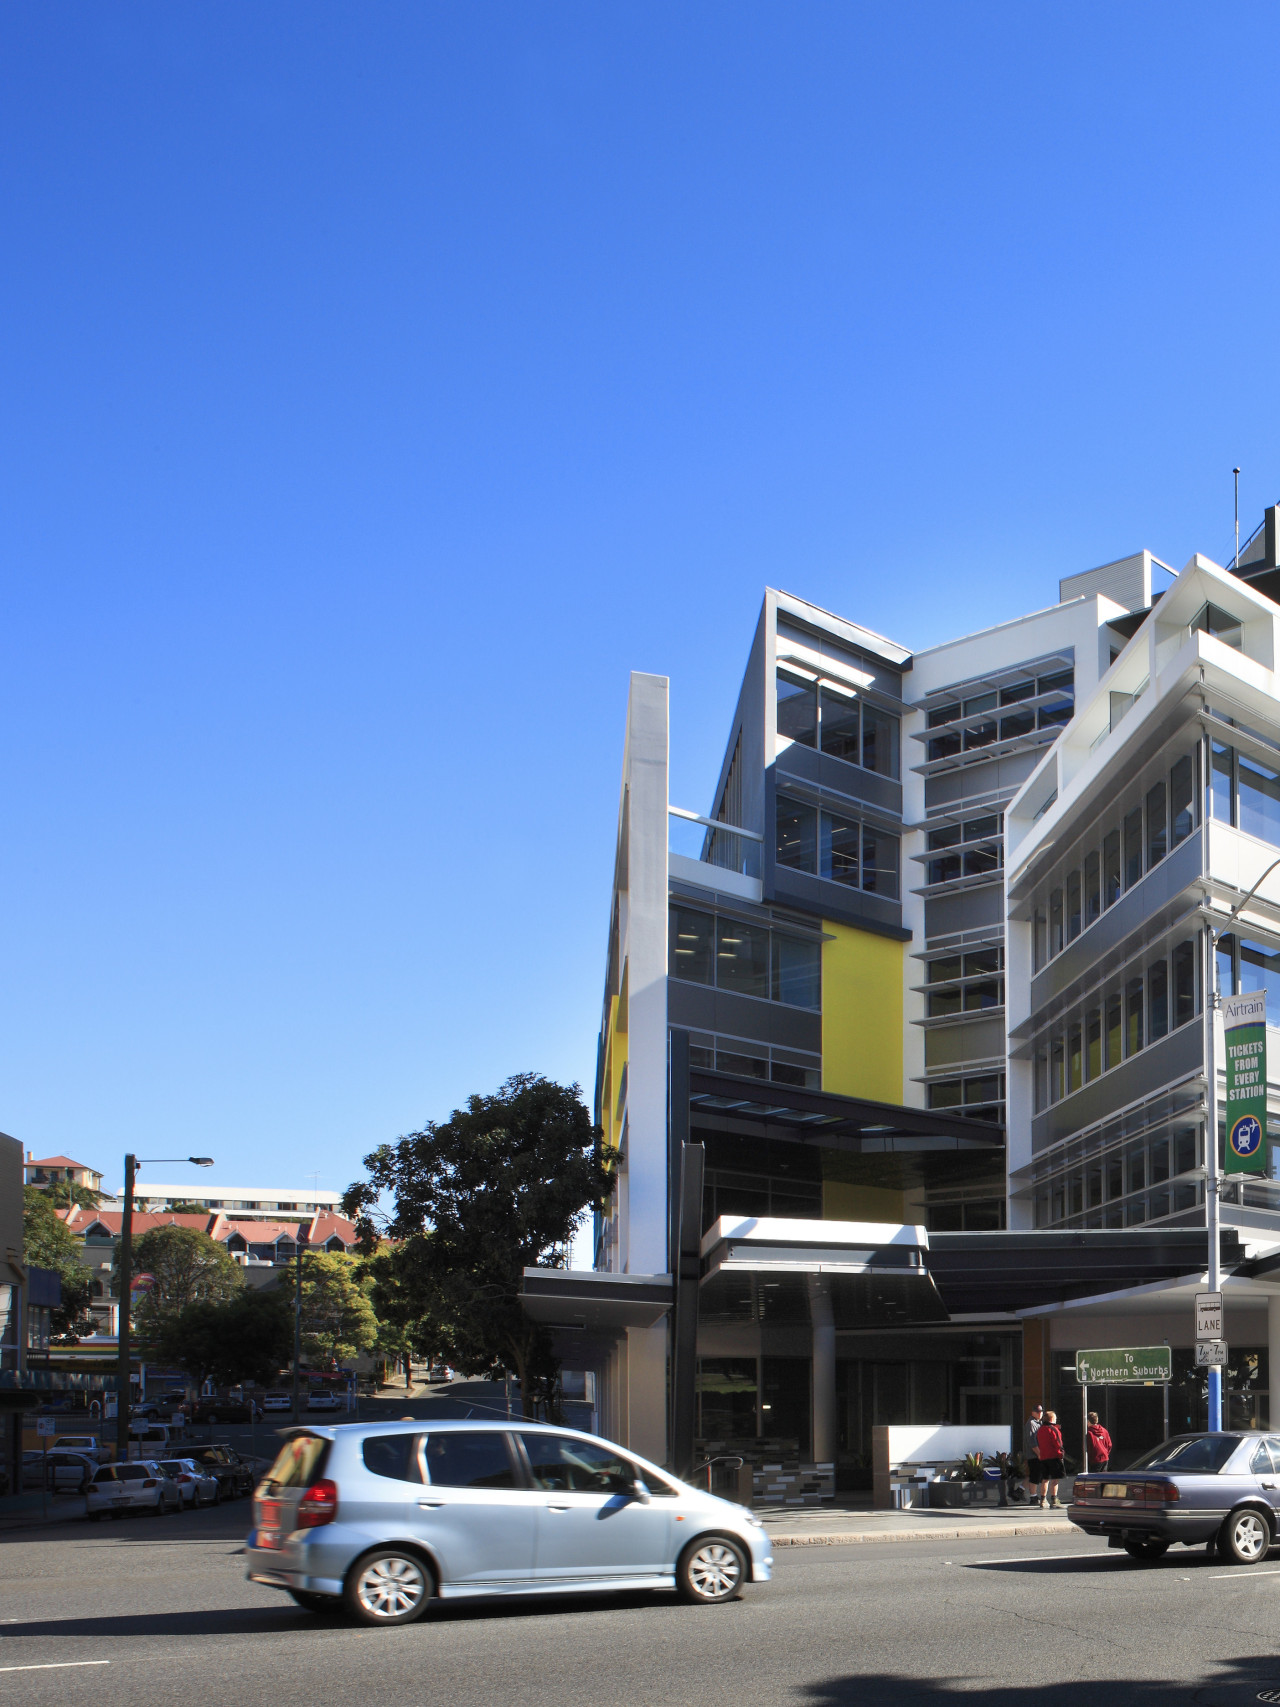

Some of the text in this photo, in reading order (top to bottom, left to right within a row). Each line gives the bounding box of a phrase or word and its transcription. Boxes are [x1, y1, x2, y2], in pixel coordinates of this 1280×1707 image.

[1226, 1000, 1263, 1018] Airtrain
[1228, 1041, 1264, 1058] TICKETS
[1234, 1056, 1259, 1072] FROM
[1234, 1071, 1260, 1086] EVERY
[1229, 1084, 1264, 1101] STATION
[1198, 1320, 1220, 1331] LANE
[1124, 1353, 1134, 1363] To
[1090, 1365, 1169, 1377] Northern Suburbs
